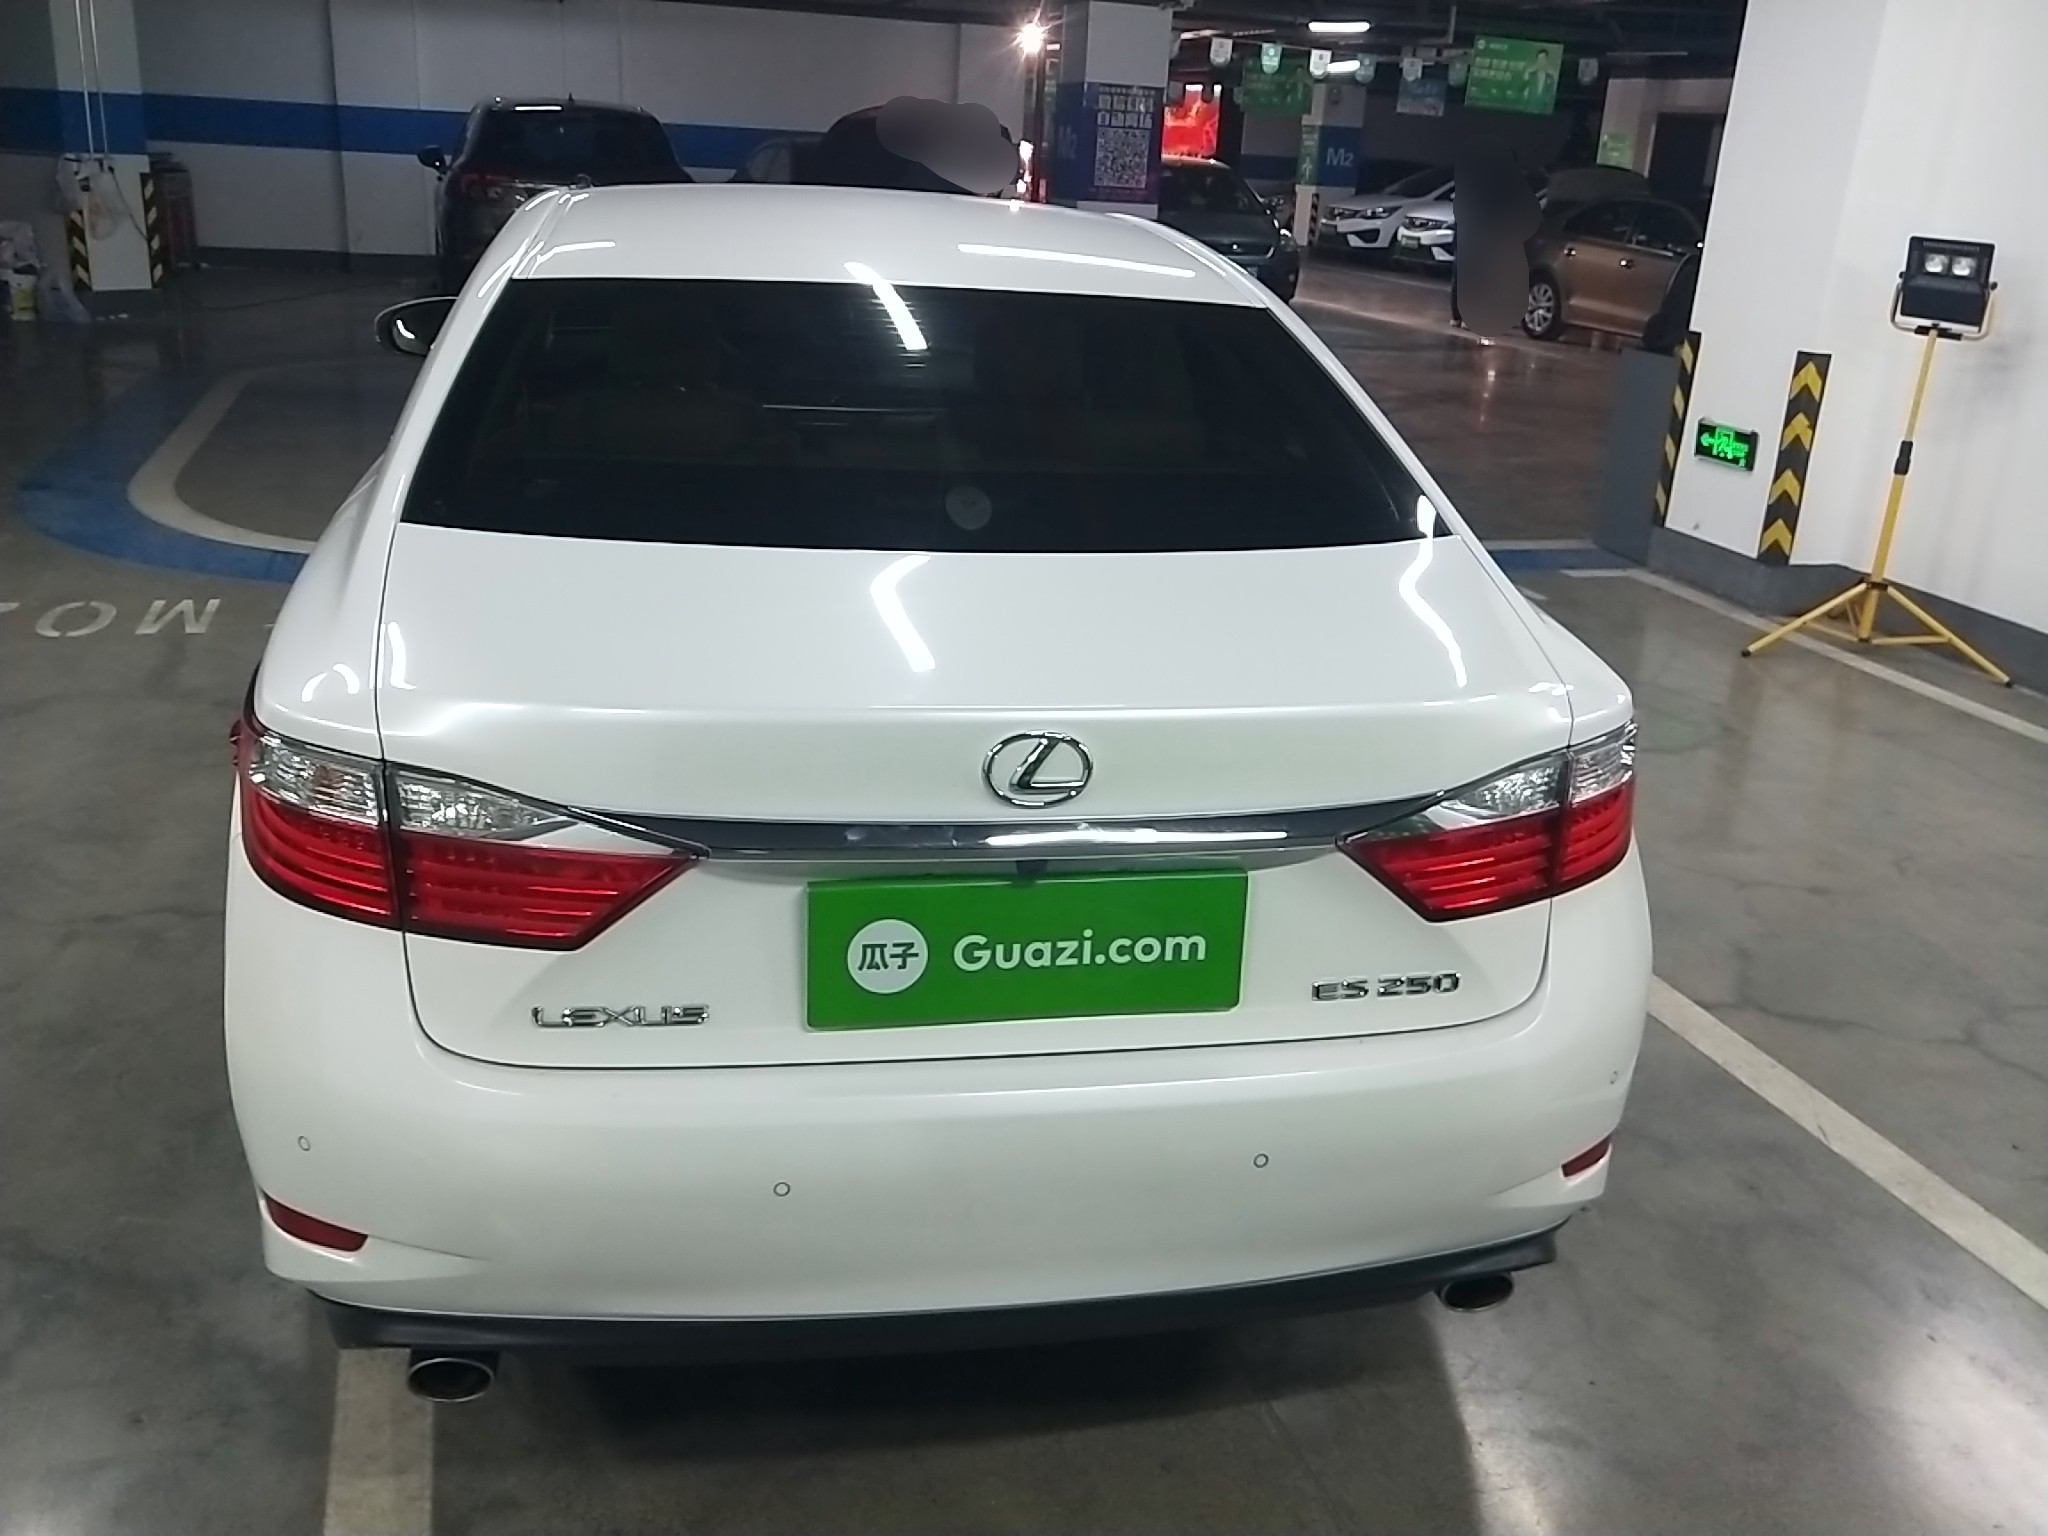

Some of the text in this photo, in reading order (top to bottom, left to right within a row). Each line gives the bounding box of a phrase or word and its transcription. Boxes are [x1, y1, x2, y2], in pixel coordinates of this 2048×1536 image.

[1326, 147, 1354, 168] M2
[857, 941, 920, 972] 瓜子
[953, 928, 1207, 973] Guazi.com
[1311, 972, 1461, 1002] ES 250
[532, 1005, 710, 1028] LEXUS
